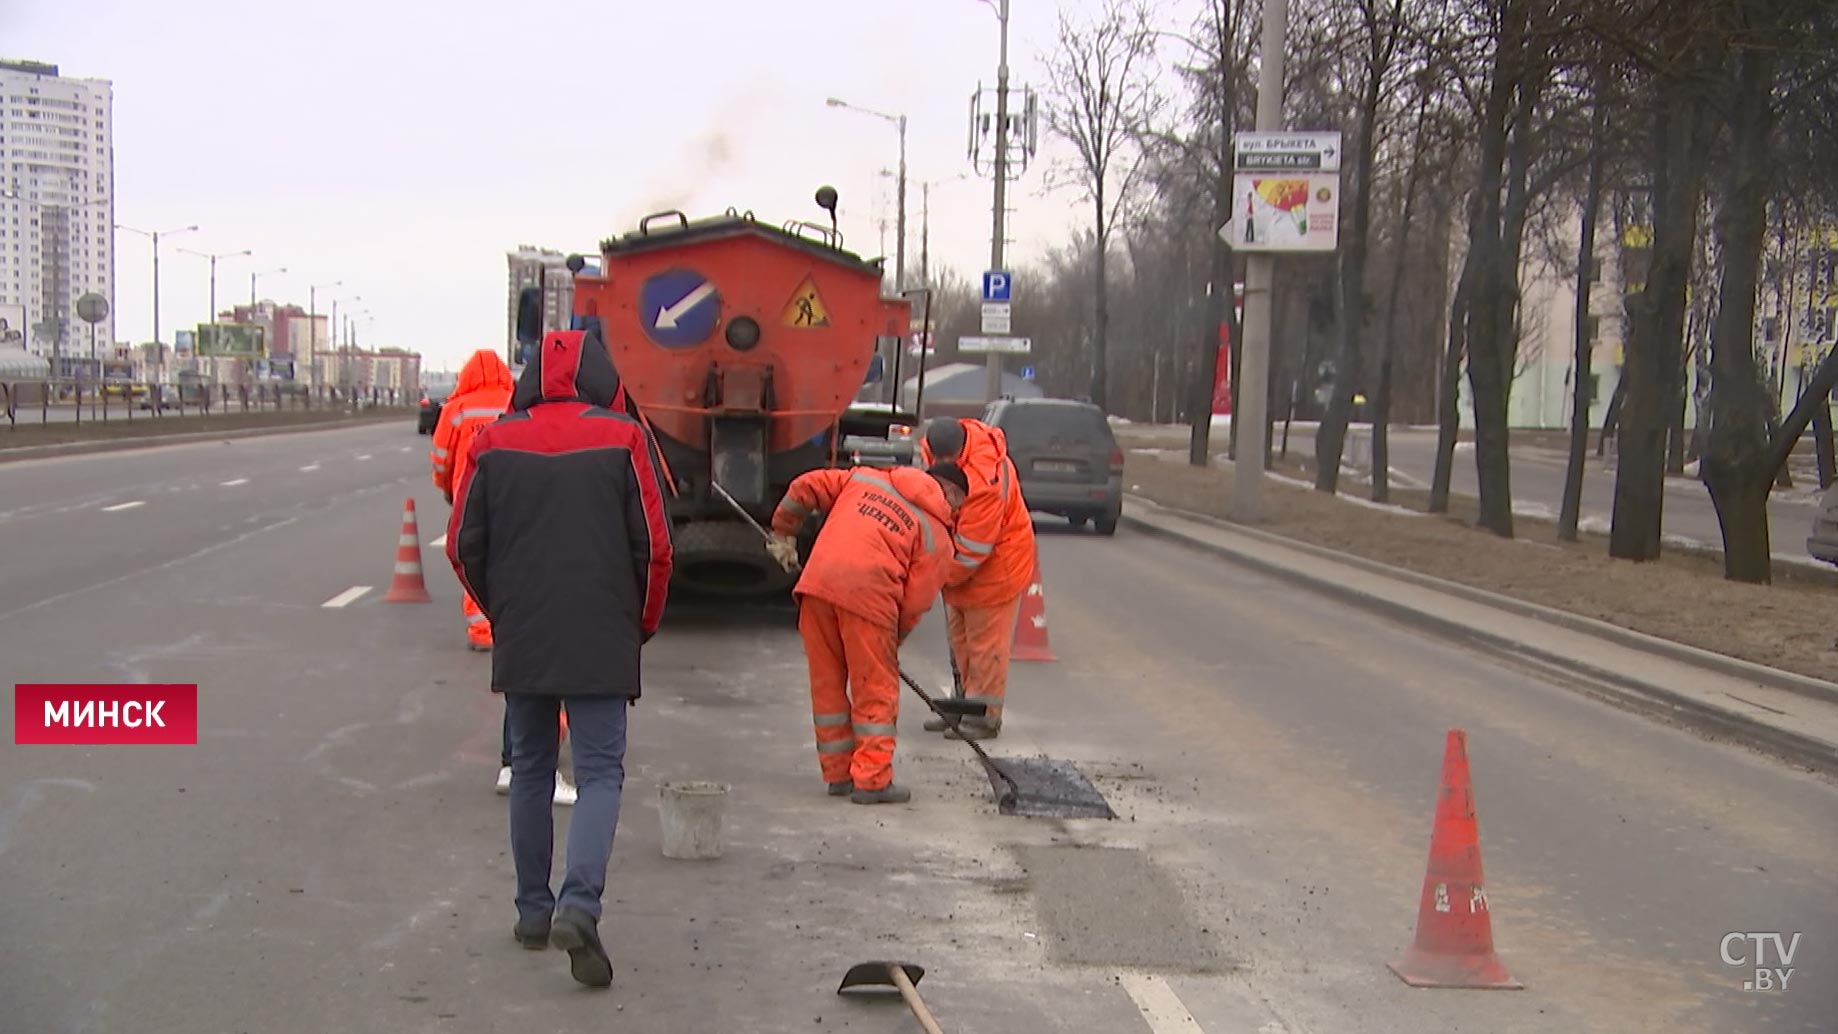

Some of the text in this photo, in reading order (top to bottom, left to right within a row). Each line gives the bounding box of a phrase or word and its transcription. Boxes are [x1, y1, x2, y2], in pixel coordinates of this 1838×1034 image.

[1266, 138, 1316, 149] БРЫКЕТА
[989, 274, 1006, 298] P
[862, 491, 914, 531] УПРАВЛЕНИЕ
